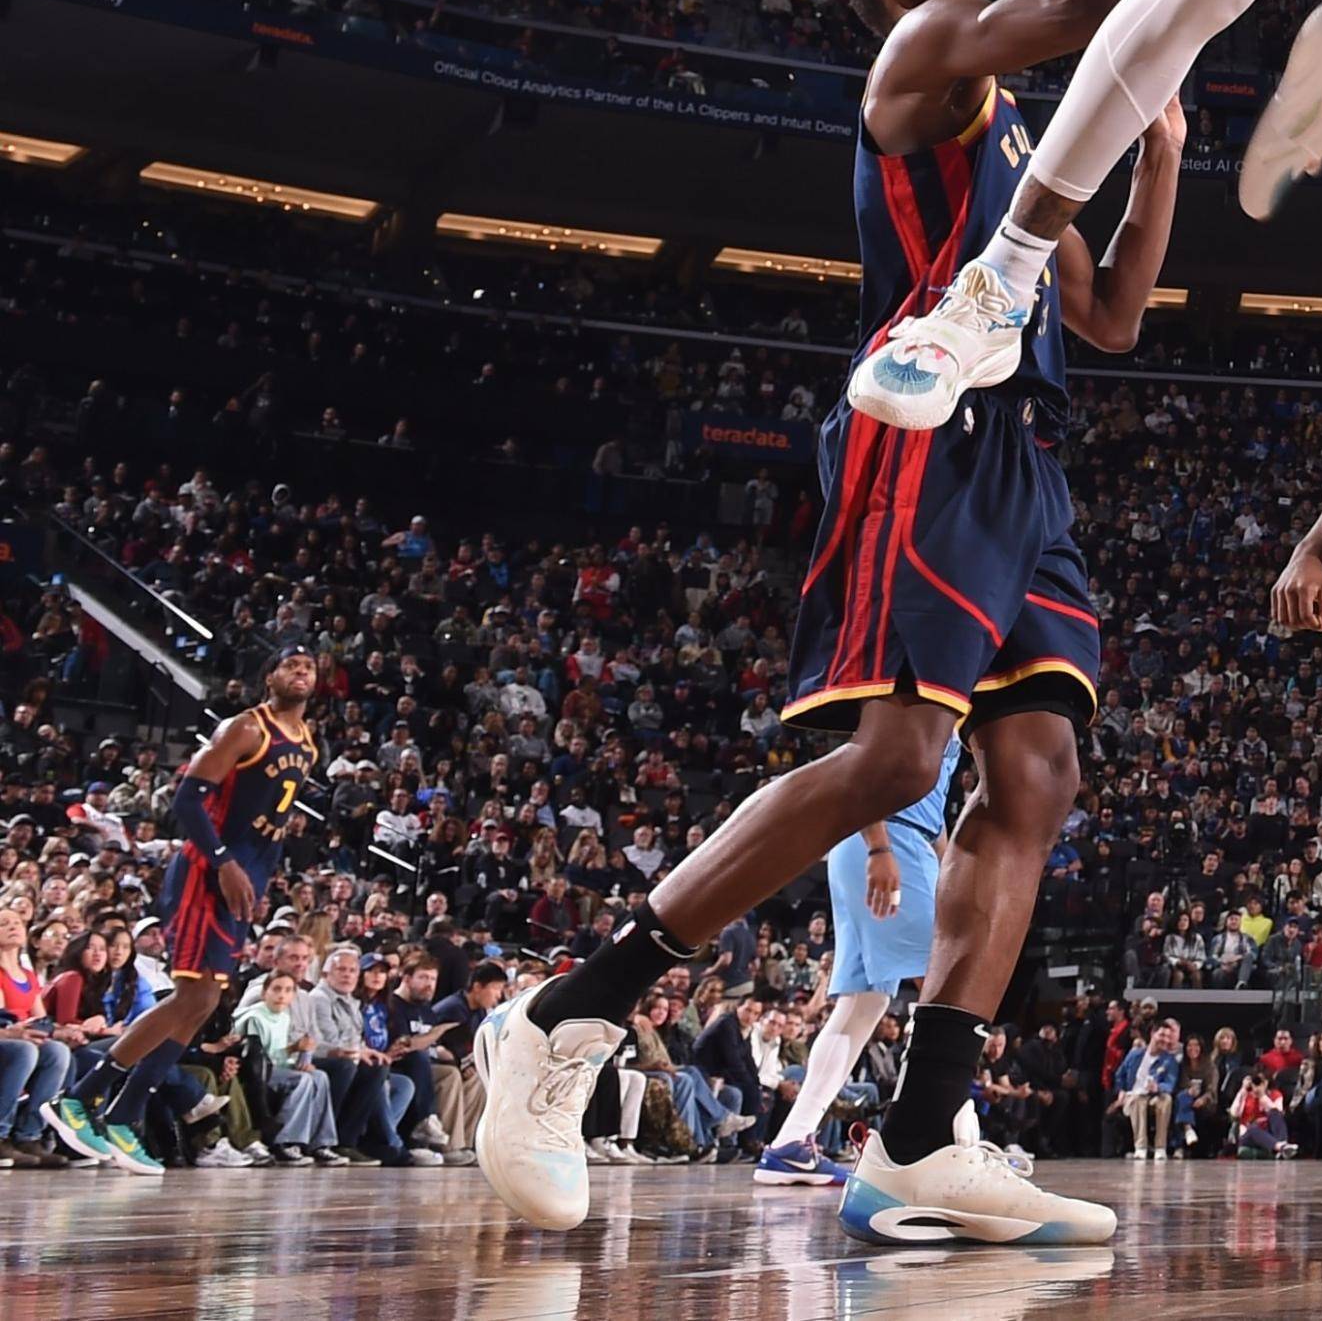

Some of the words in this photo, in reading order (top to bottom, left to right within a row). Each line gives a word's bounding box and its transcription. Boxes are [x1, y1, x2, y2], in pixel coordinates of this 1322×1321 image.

[433, 60, 479, 81] Official
[481, 71, 519, 90] Cloud
[522, 80, 583, 99] Analytics
[585, 88, 633, 106] Partner
[652, 98, 674, 112] the
[677, 100, 695, 114] LA
[699, 104, 750, 123] Clippers
[753, 112, 778, 126] and
[815, 120, 852, 137] Dome
[1216, 159, 1231, 172] AI
